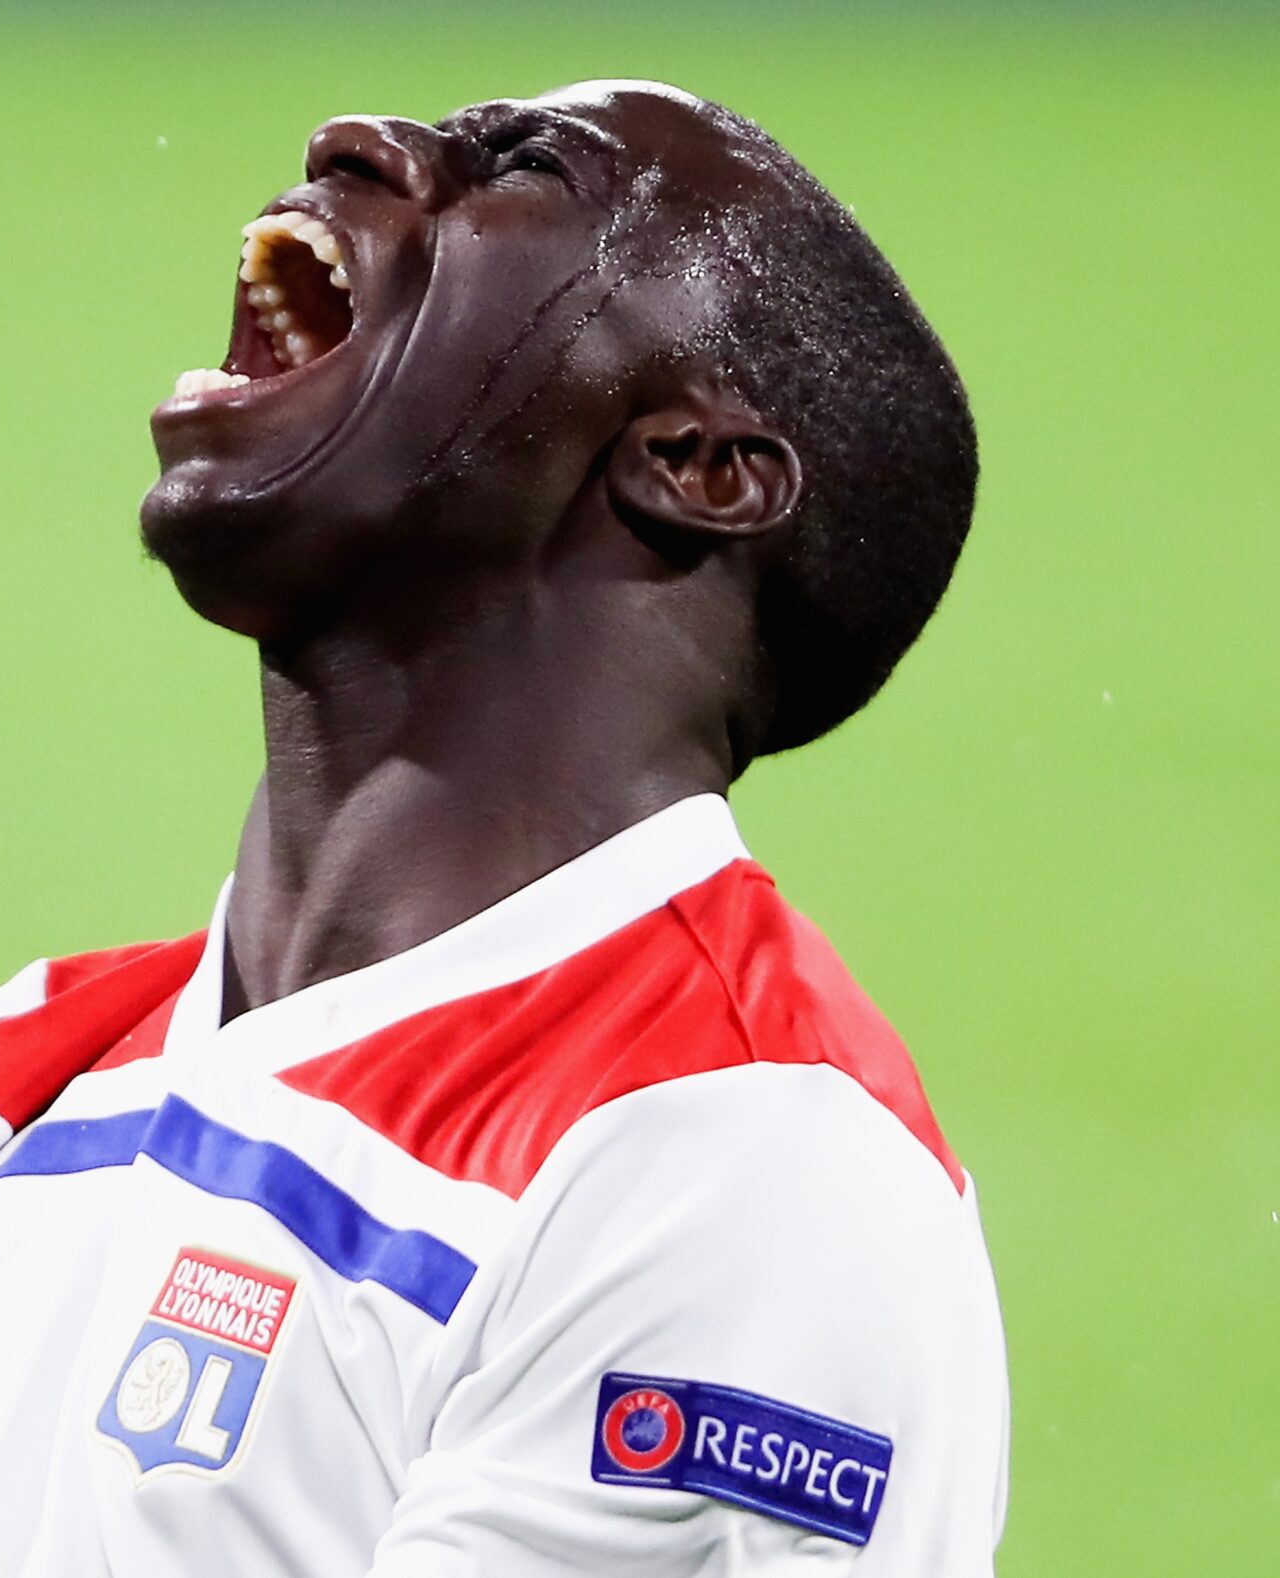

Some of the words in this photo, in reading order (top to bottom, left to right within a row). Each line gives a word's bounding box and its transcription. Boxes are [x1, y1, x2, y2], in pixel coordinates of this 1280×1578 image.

[158, 1286, 275, 1345] LYONNAIS
[172, 1258, 286, 1317] OLYMPIQUE
[623, 1393, 670, 1414] UEFA
[692, 1415, 887, 1514] RESPECT
